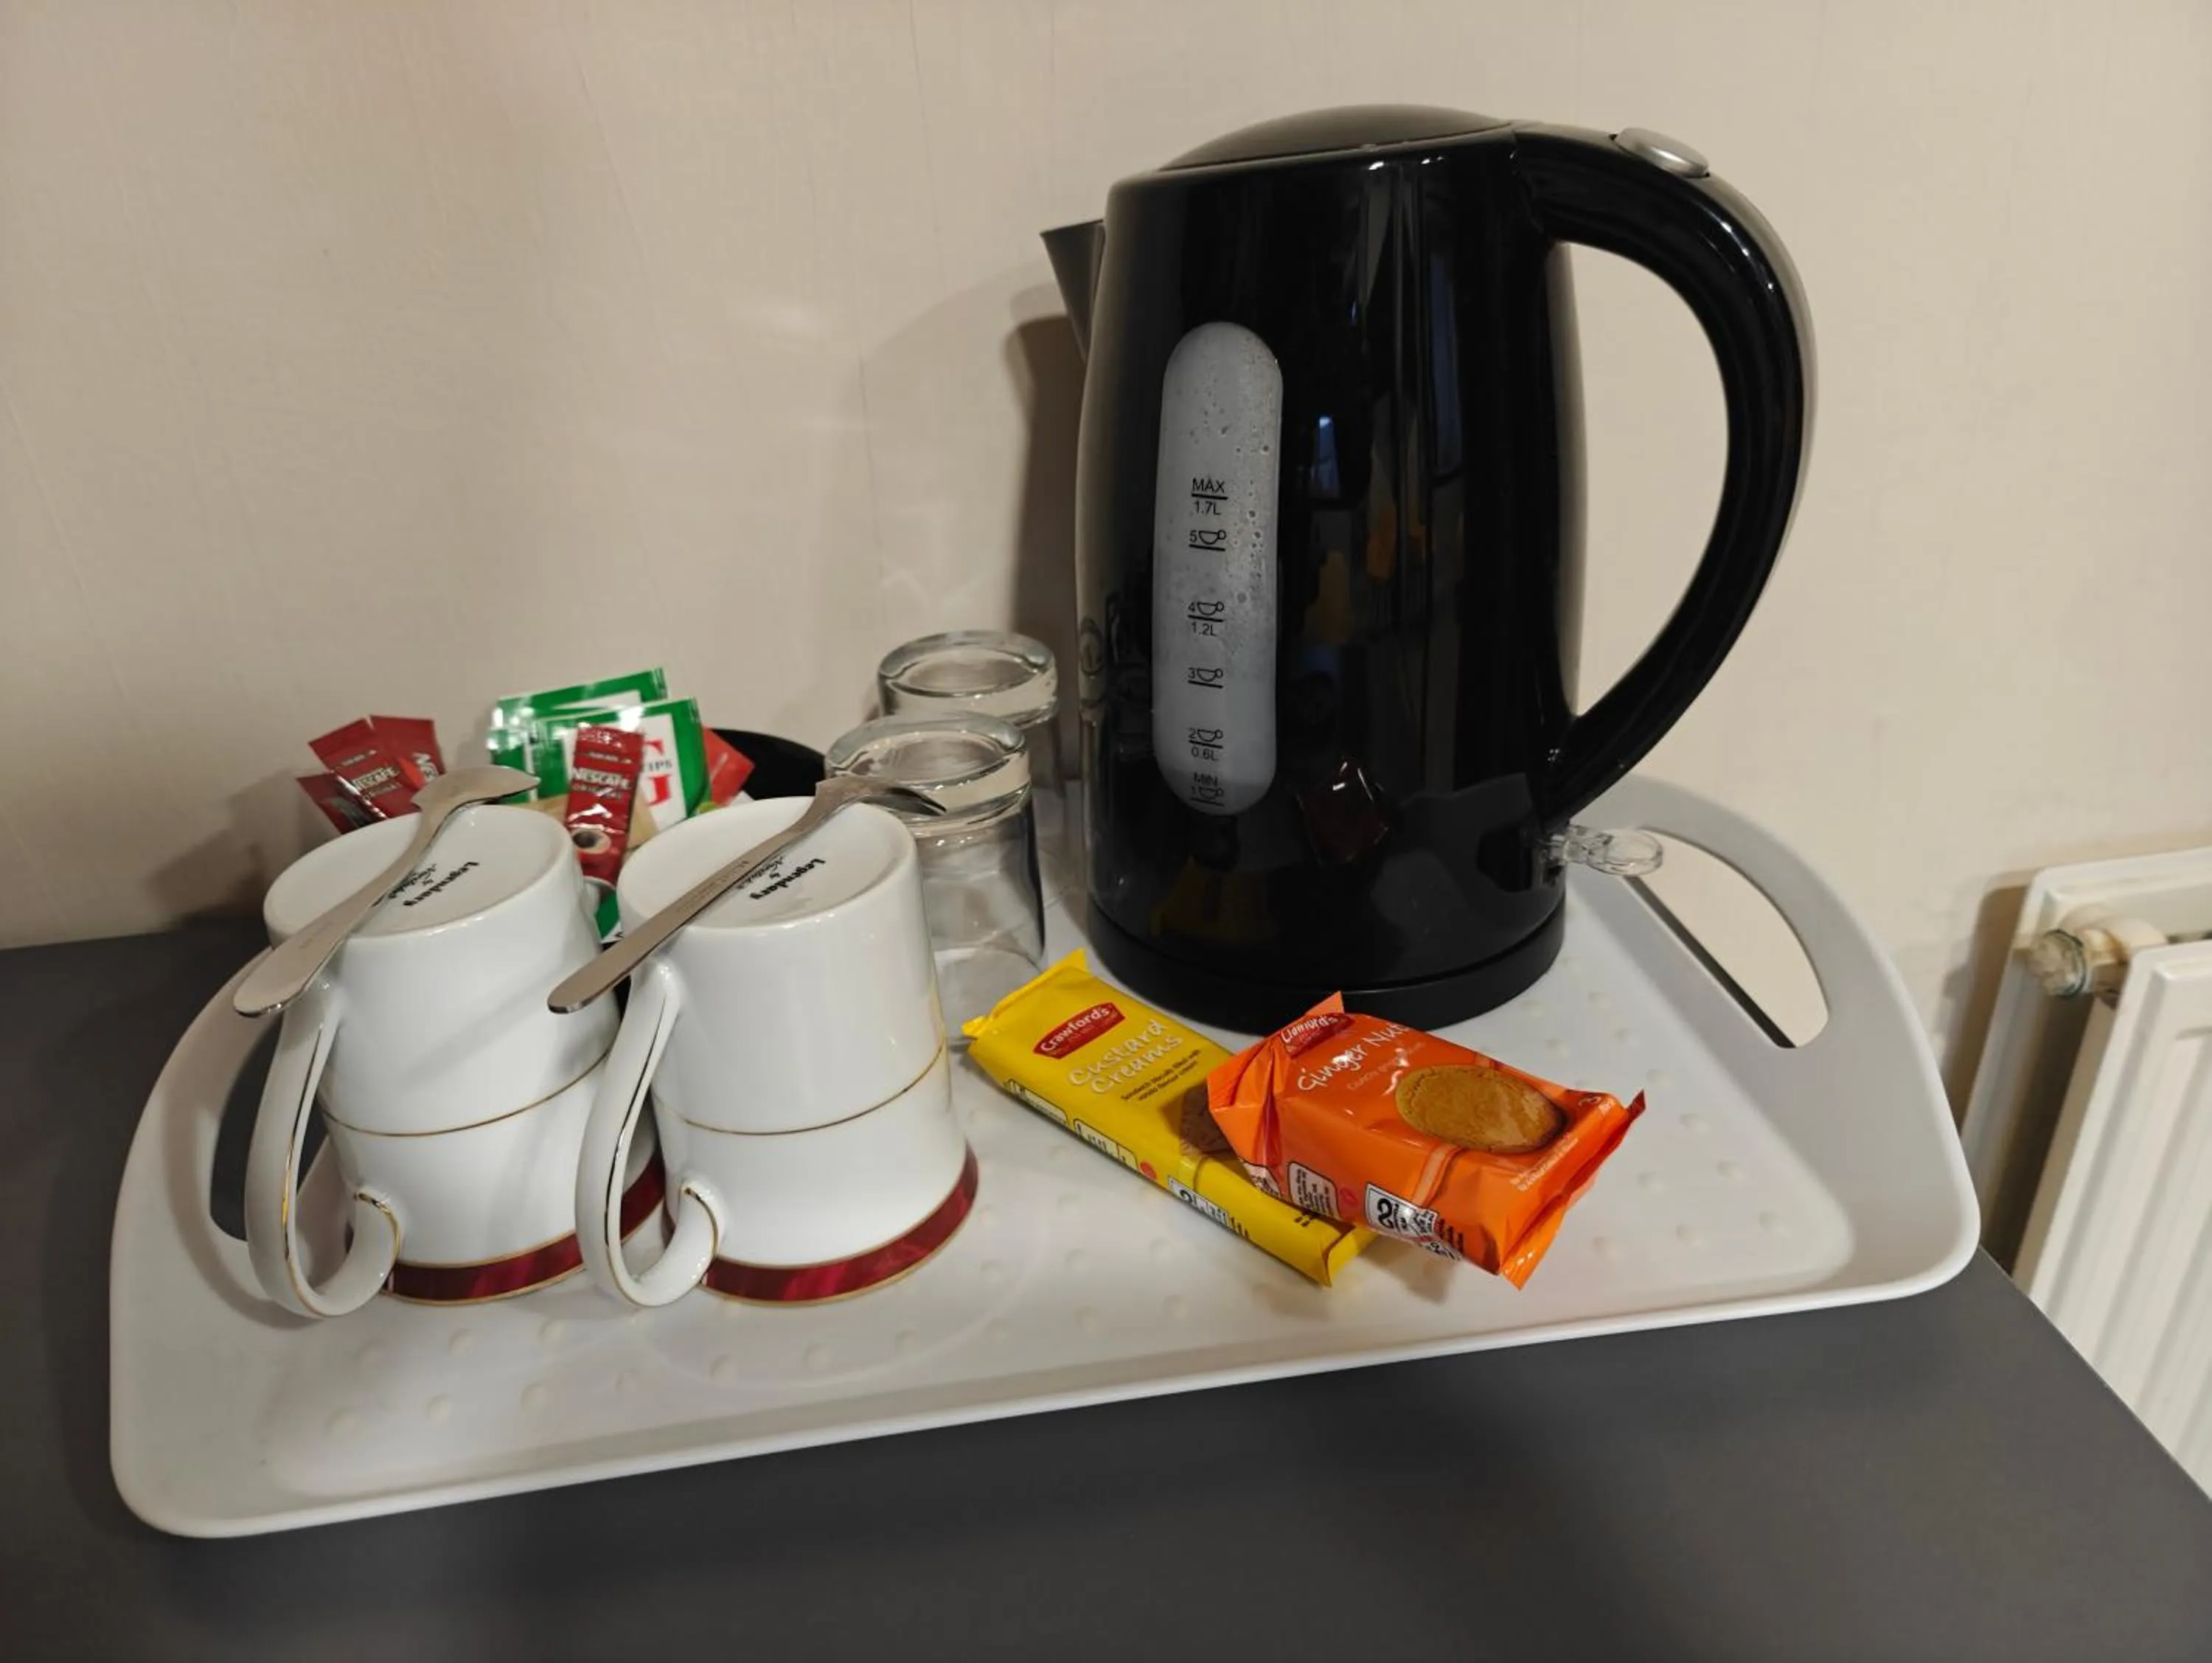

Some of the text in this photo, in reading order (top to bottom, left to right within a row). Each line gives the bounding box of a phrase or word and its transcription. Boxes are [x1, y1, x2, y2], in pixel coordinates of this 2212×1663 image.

[1192, 477, 1225, 493] MAX
[1193, 500, 1221, 515] 1.7L
[1189, 530, 1197, 543] 5
[1188, 602, 1195, 613] 4
[1191, 621, 1218, 637] 1.2L
[1187, 666, 1195, 679] 3
[750, 859, 826, 899] Legendary
[1068, 1019, 1169, 1086] Custard
[1090, 1035, 1182, 1094] Creams
